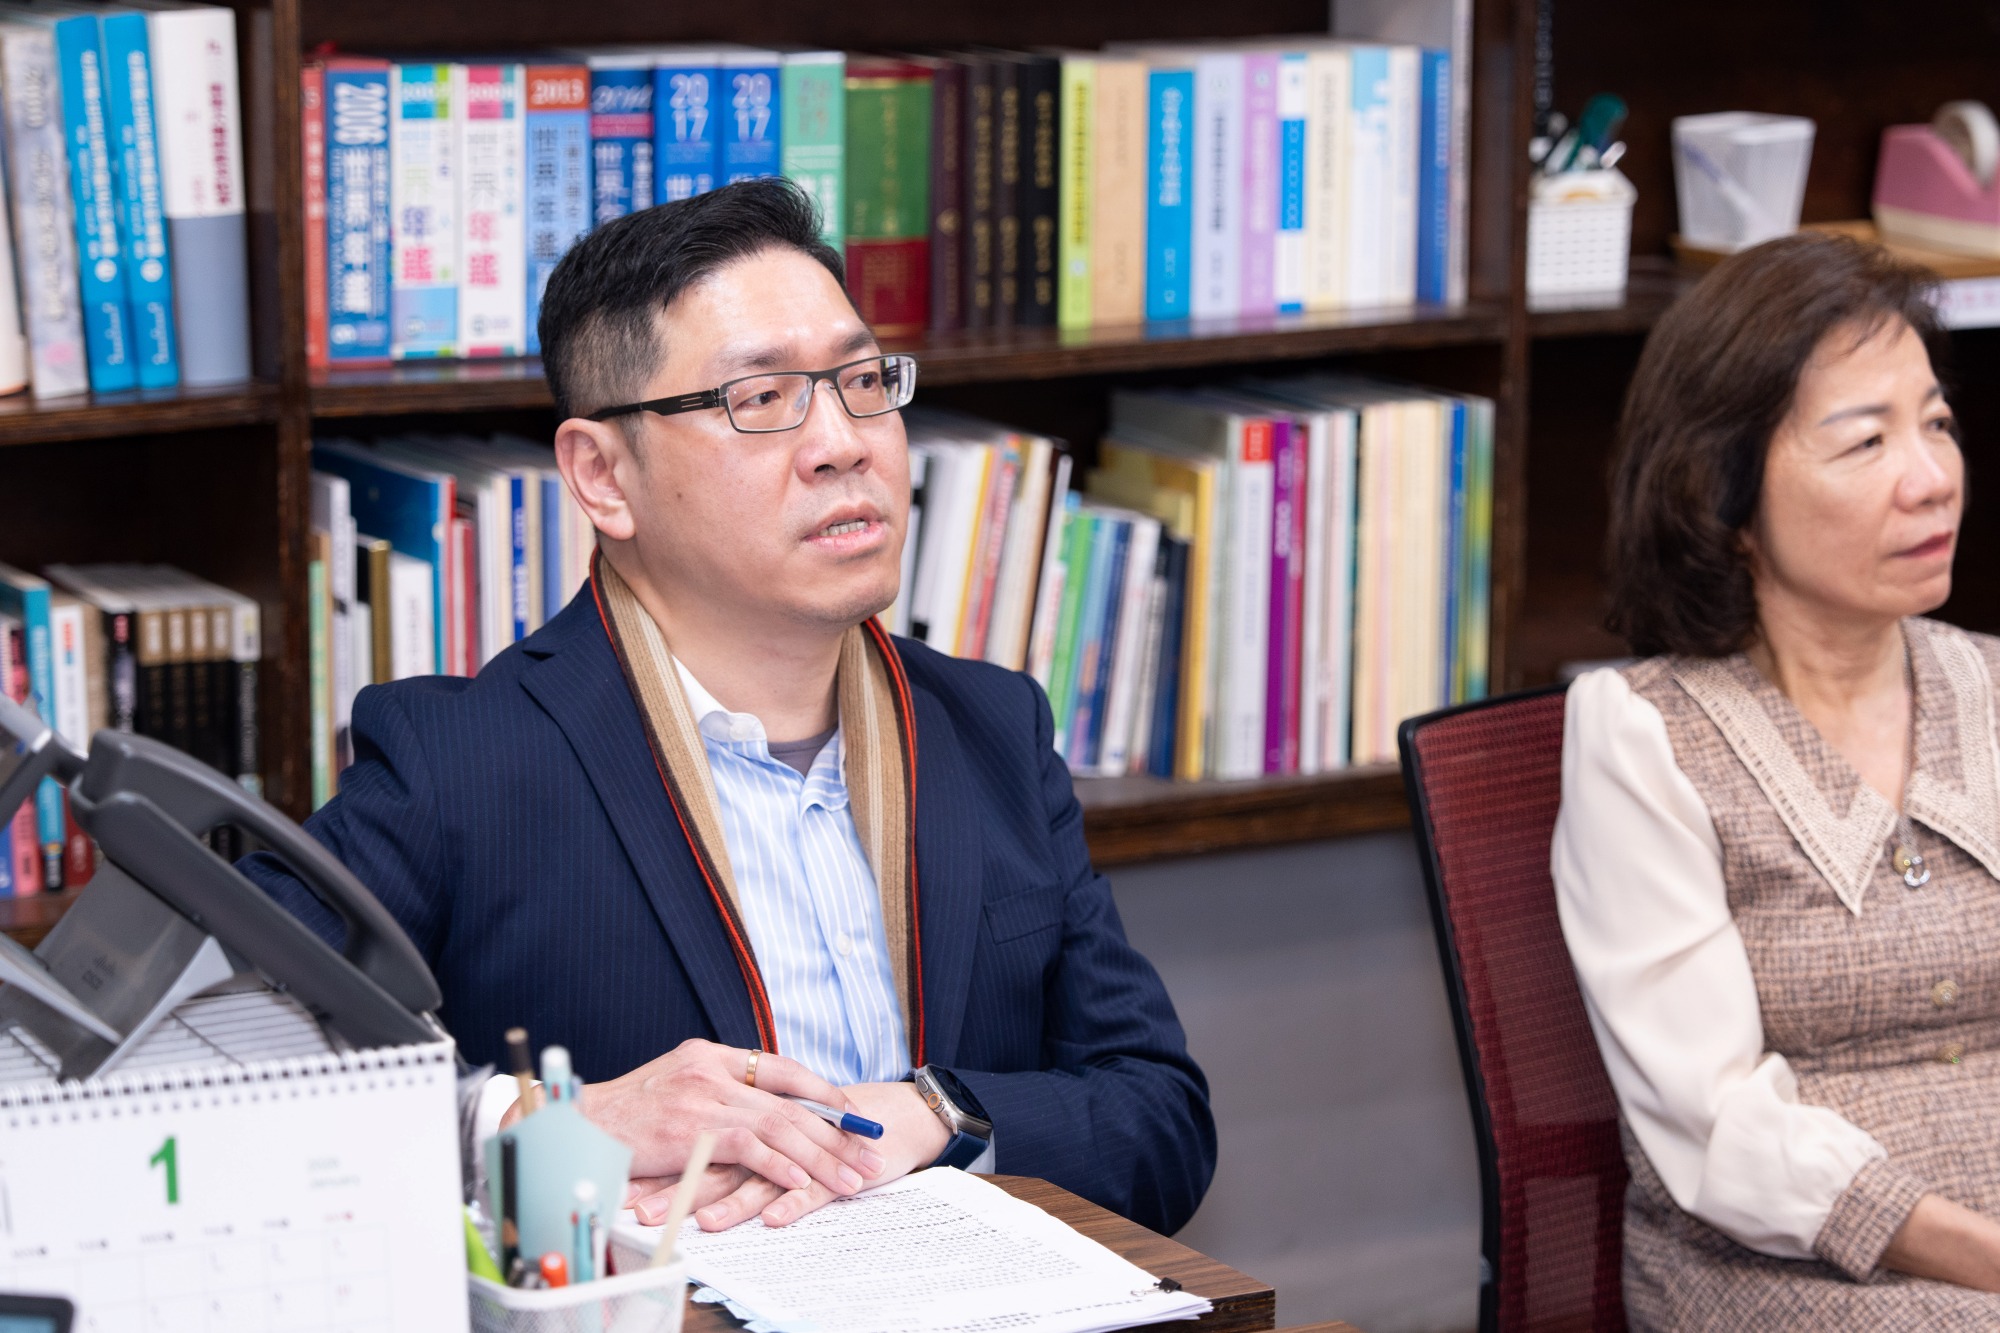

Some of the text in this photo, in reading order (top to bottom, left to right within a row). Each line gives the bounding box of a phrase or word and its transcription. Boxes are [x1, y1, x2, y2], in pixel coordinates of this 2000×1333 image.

[334, 82, 387, 145] 2006
[531, 79, 585, 105] 2013
[532, 127, 558, 260] 世界年鑑
[343, 148, 371, 314] 世界年鑑
[149, 1136, 179, 1204] 1
